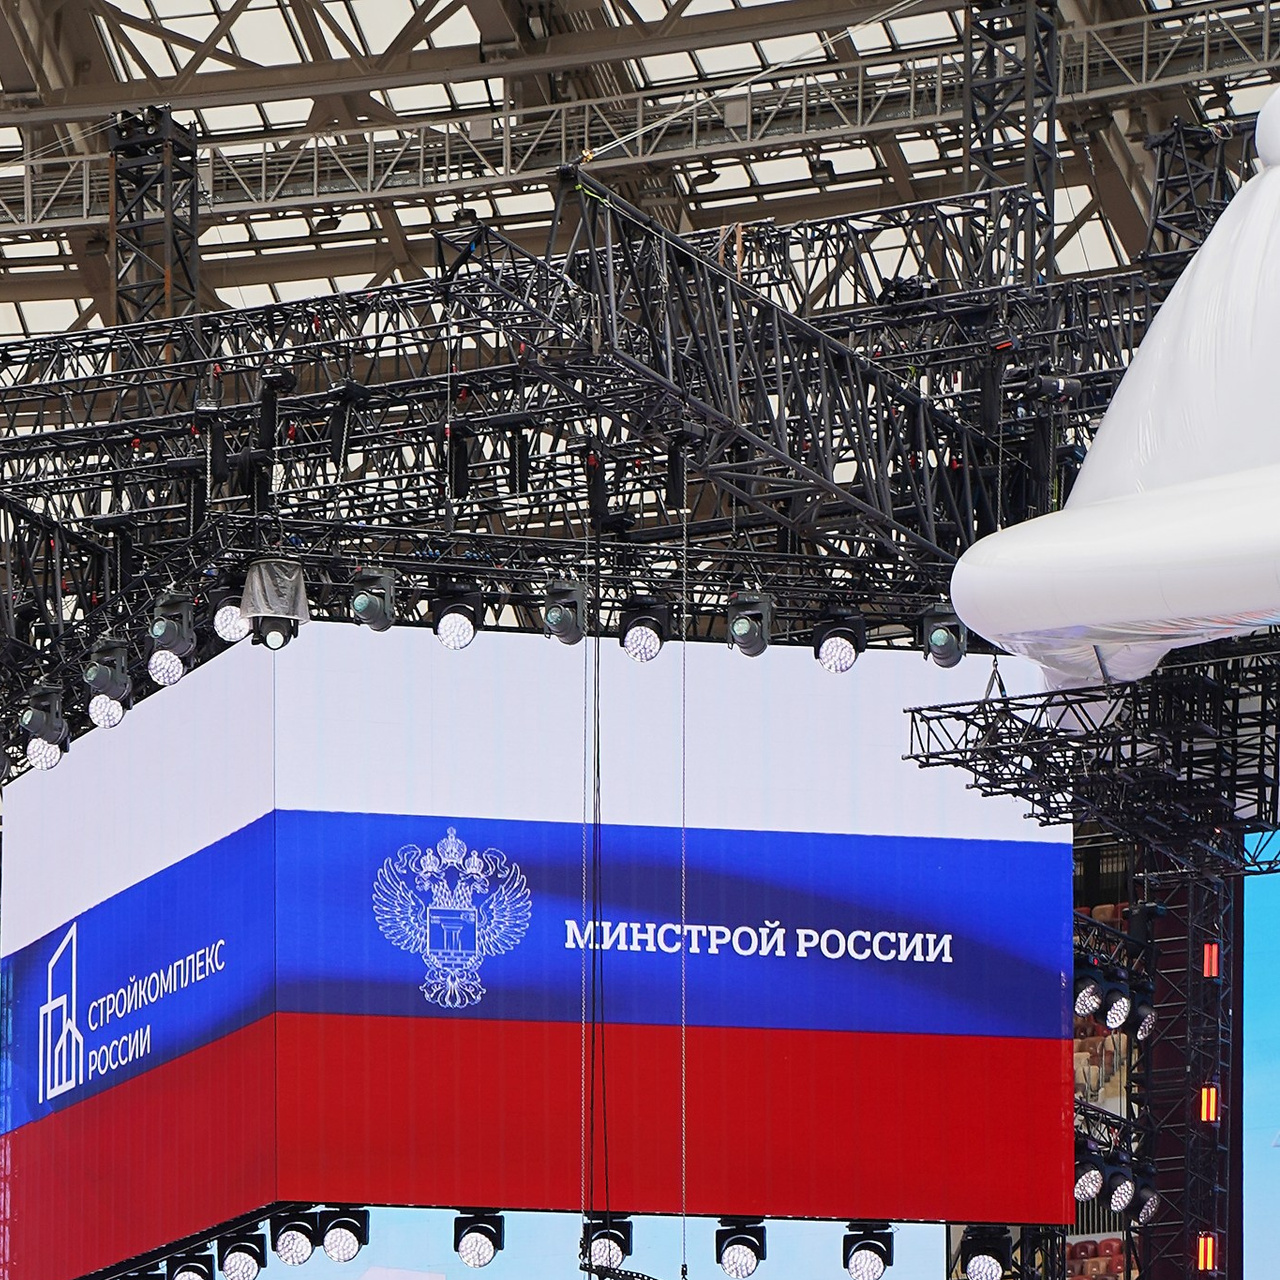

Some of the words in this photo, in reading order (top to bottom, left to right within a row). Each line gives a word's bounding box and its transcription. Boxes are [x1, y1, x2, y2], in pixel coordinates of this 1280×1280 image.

[564, 919, 786, 957] МИНСТРОЙ
[795, 928, 953, 963] РОССИИ
[87, 938, 226, 1032] СТРОЙКОМПЛЕКС
[87, 1024, 151, 1081] РОССИИ
